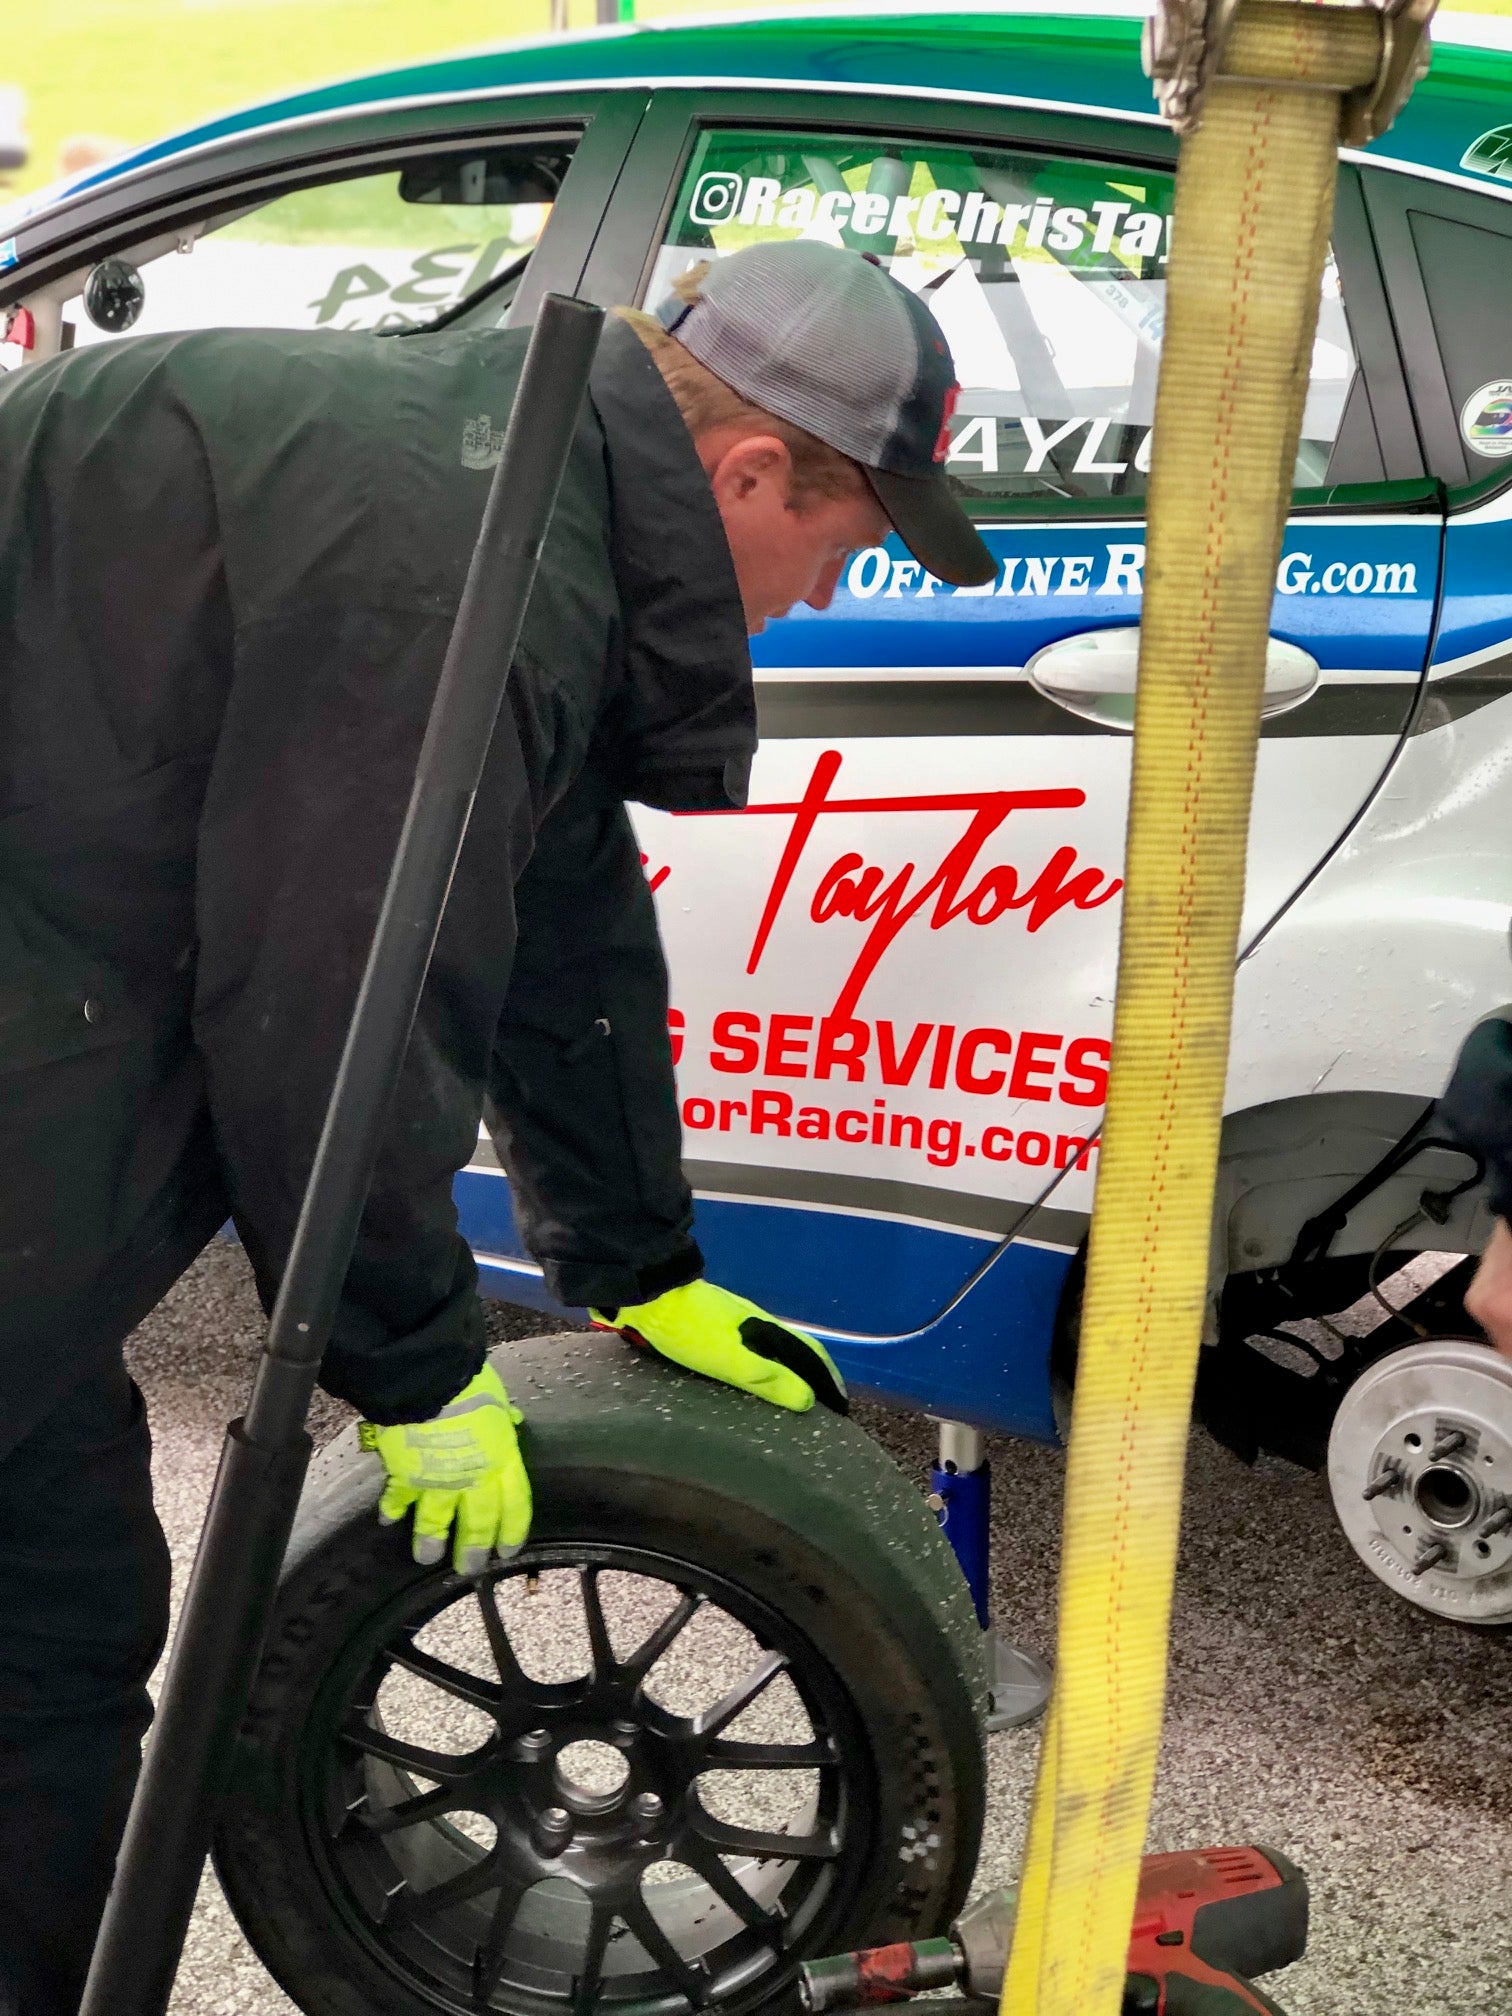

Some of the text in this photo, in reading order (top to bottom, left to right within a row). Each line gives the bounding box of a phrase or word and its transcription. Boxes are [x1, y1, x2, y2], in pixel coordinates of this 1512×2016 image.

[671, 749, 1123, 1020] Taylor
[710, 1011, 1112, 1108] SERVICES
[676, 1085, 1101, 1172] orRacing.com
